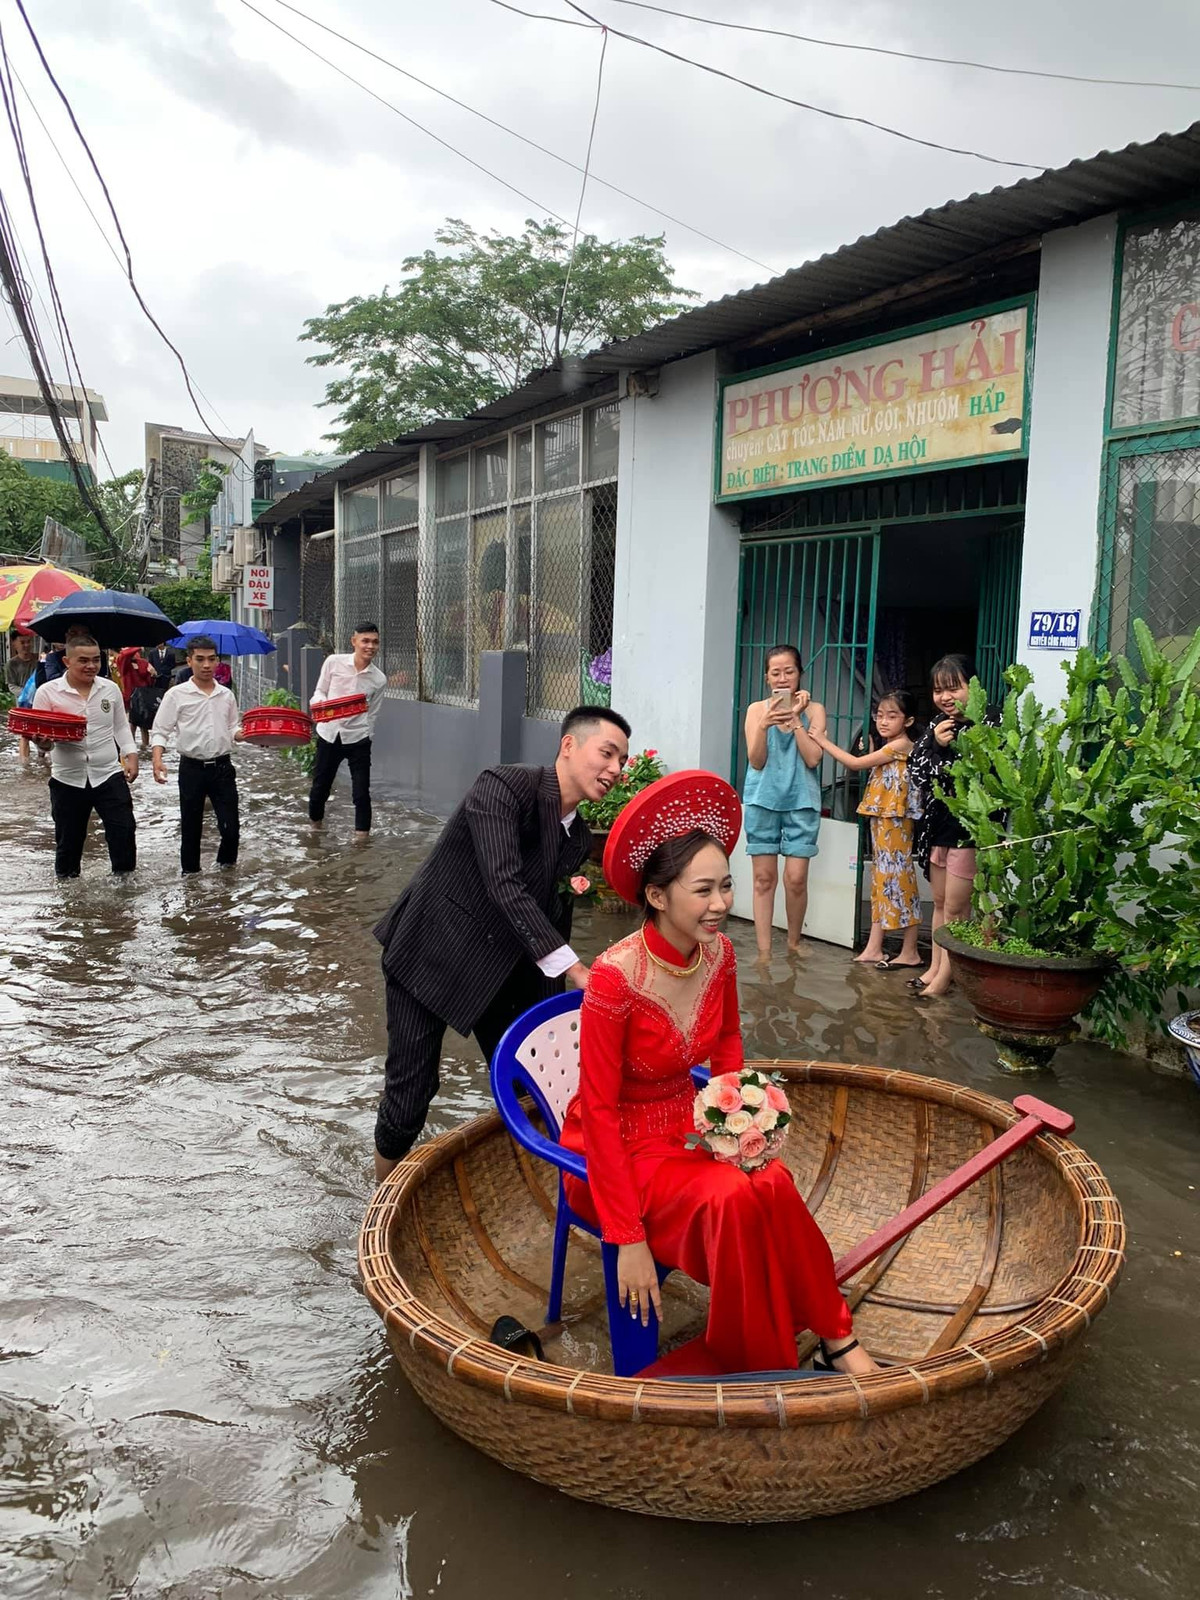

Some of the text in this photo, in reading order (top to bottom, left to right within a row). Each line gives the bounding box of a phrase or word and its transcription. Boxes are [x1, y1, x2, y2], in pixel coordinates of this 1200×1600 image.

[726, 319, 1021, 435] PHƯƠNG HẢI
[766, 423, 789, 453] CẮT
[905, 391, 961, 428] NHUỘM
[969, 382, 1006, 417] HẤP
[786, 456, 829, 479] TRANG
[831, 441, 866, 473] ĐIỂM
[873, 445, 894, 468] DẠ
[898, 433, 927, 465] HỘI
[250, 568, 269, 577] NƠI
[248, 578, 271, 591] ĐẬU
[252, 591, 267, 601] XE
[1033, 613, 1077, 634] 79/19
